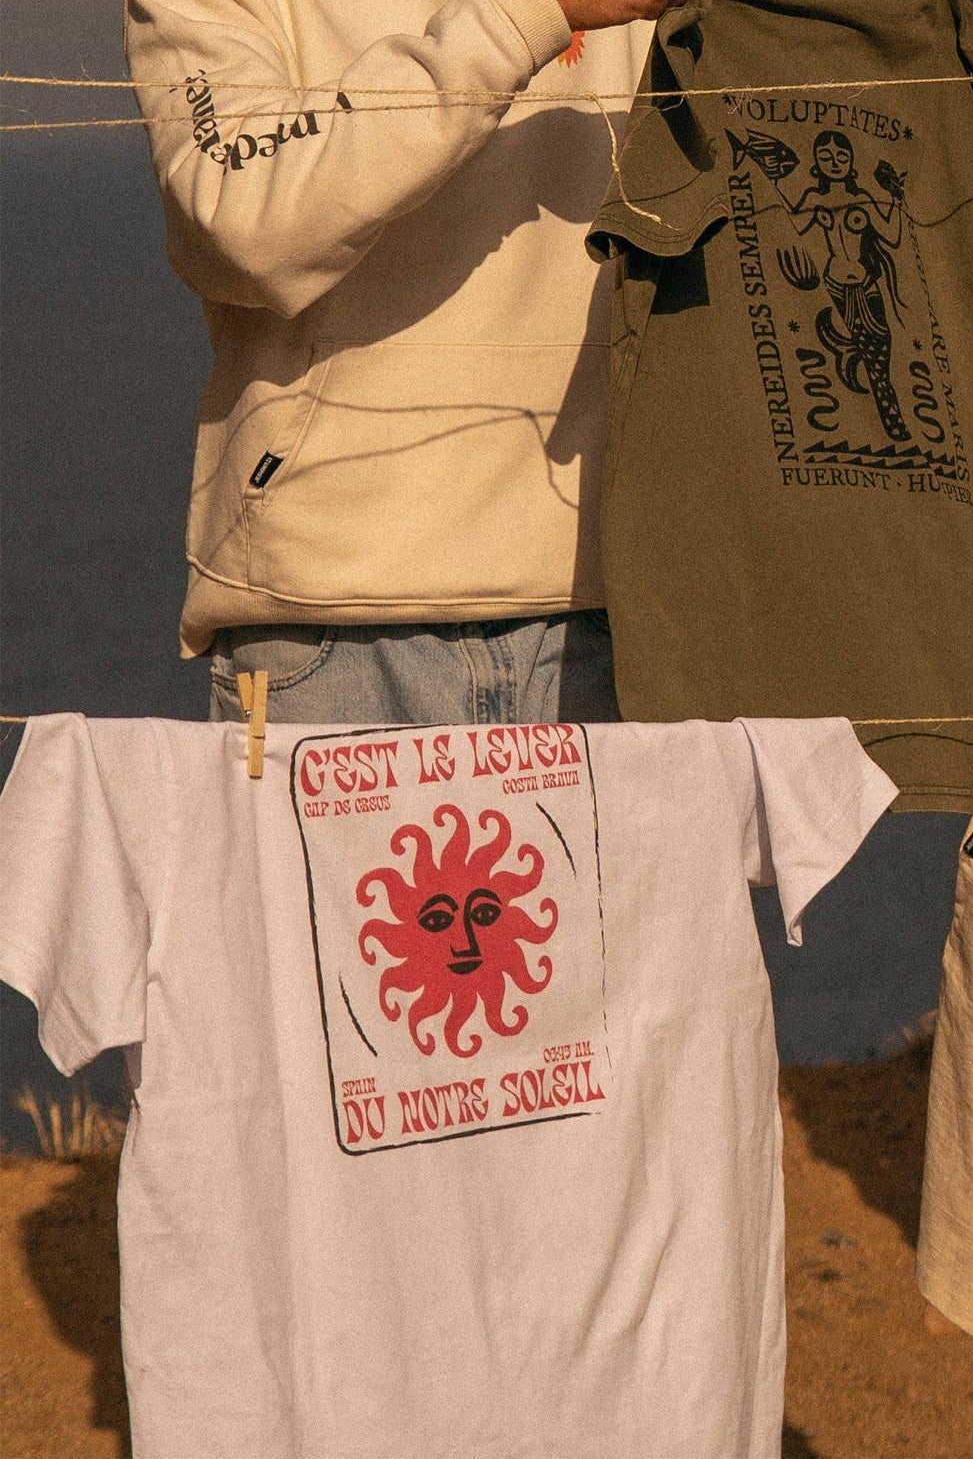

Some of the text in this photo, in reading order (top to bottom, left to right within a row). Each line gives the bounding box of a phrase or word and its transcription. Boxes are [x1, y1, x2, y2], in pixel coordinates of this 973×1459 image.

[730, 94, 901, 141] VOLUPTATES
[728, 171, 799, 463] NEREIDES SEMPER
[942, 382, 971, 483] MARIS
[780, 467, 891, 491] FUERUNT
[300, 724, 582, 797] C'EST LE LEVER
[502, 770, 580, 795] COSTA BRAVA
[303, 794, 392, 818] CAP DE CREUS
[341, 1077, 377, 1098] SPAIN
[341, 1059, 607, 1145] DU NOTRE SOLEIL
